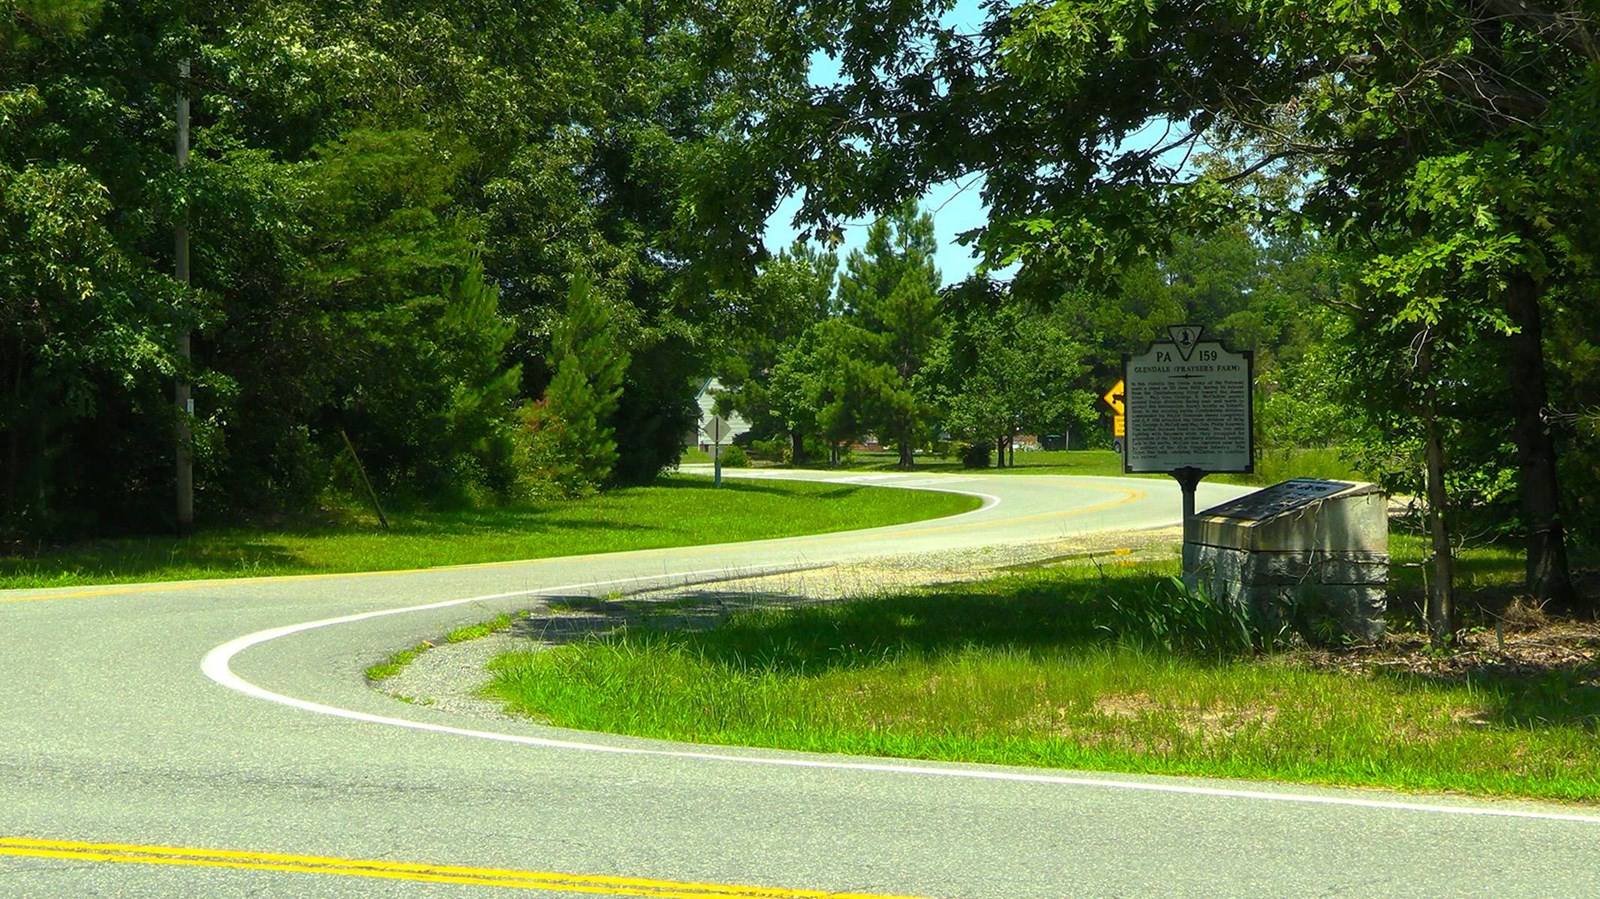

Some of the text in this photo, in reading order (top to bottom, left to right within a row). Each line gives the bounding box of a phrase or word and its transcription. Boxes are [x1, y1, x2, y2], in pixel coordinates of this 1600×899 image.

[1156, 350, 1218, 362] PA 159
[1217, 364, 1240, 372] FARM)
